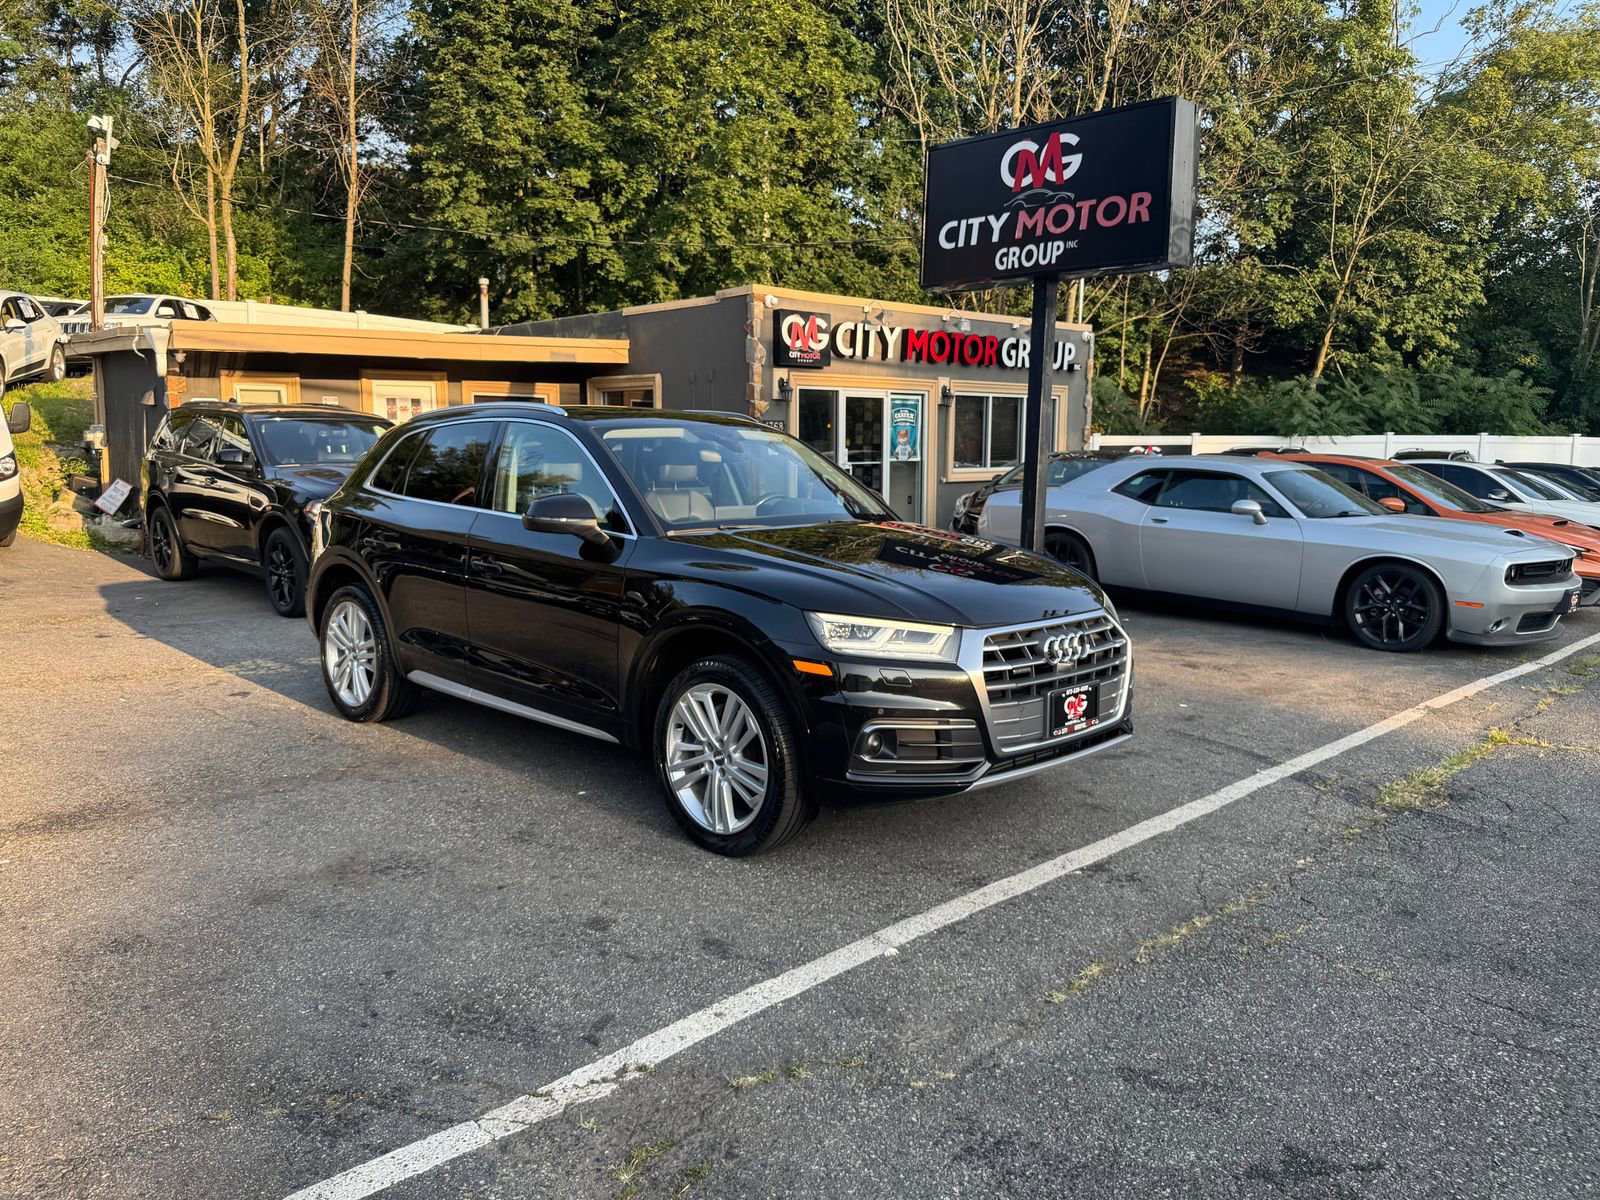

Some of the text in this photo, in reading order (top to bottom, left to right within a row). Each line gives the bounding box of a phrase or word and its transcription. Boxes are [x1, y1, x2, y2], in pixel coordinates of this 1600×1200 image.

[938, 191, 1152, 250] CITY MOTOR
[994, 240, 1079, 271] GROUP INC
[788, 350, 800, 359] CITY
[835, 321, 902, 359] CITY
[907, 328, 999, 367] MOTOR
[1001, 336, 1076, 371] GRUP
